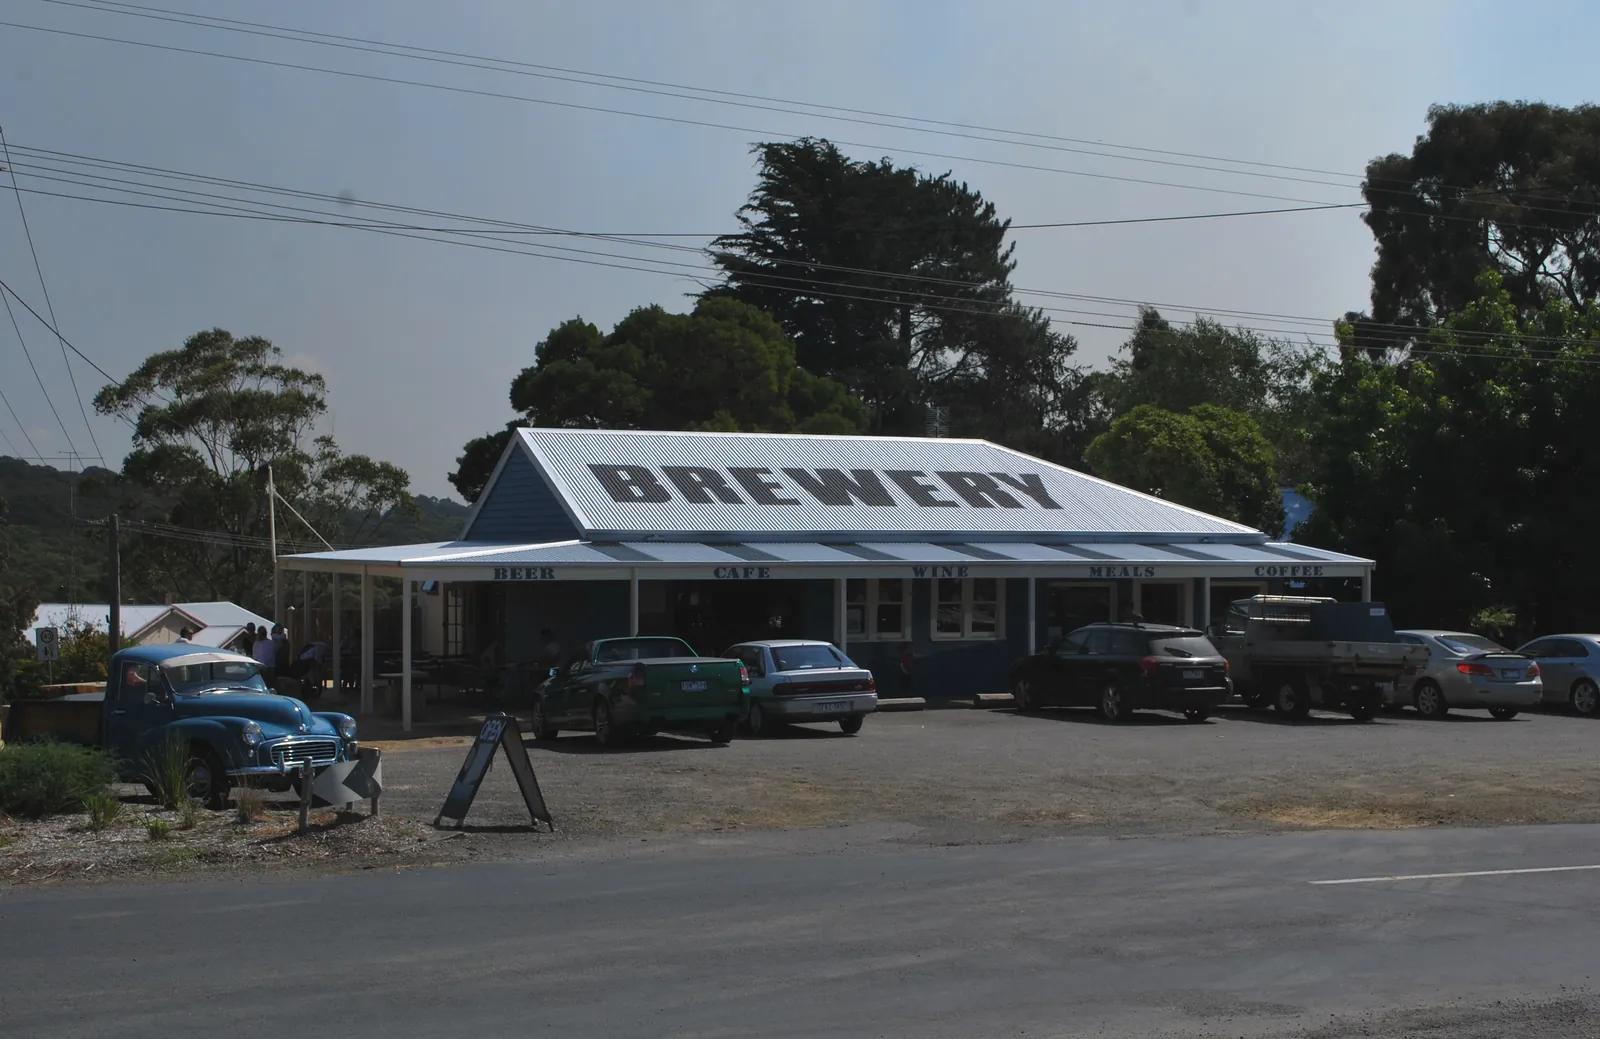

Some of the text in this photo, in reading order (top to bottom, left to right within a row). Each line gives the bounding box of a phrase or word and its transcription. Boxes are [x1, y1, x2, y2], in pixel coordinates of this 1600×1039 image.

[587, 464, 1063, 510] BREWERY
[493, 567, 555, 580] BEER
[713, 566, 771, 579] CAFE
[912, 566, 969, 578] WINE
[1089, 566, 1156, 578] MEALS
[1254, 565, 1324, 577] COFFEE
[479, 719, 507, 742] OPEN
